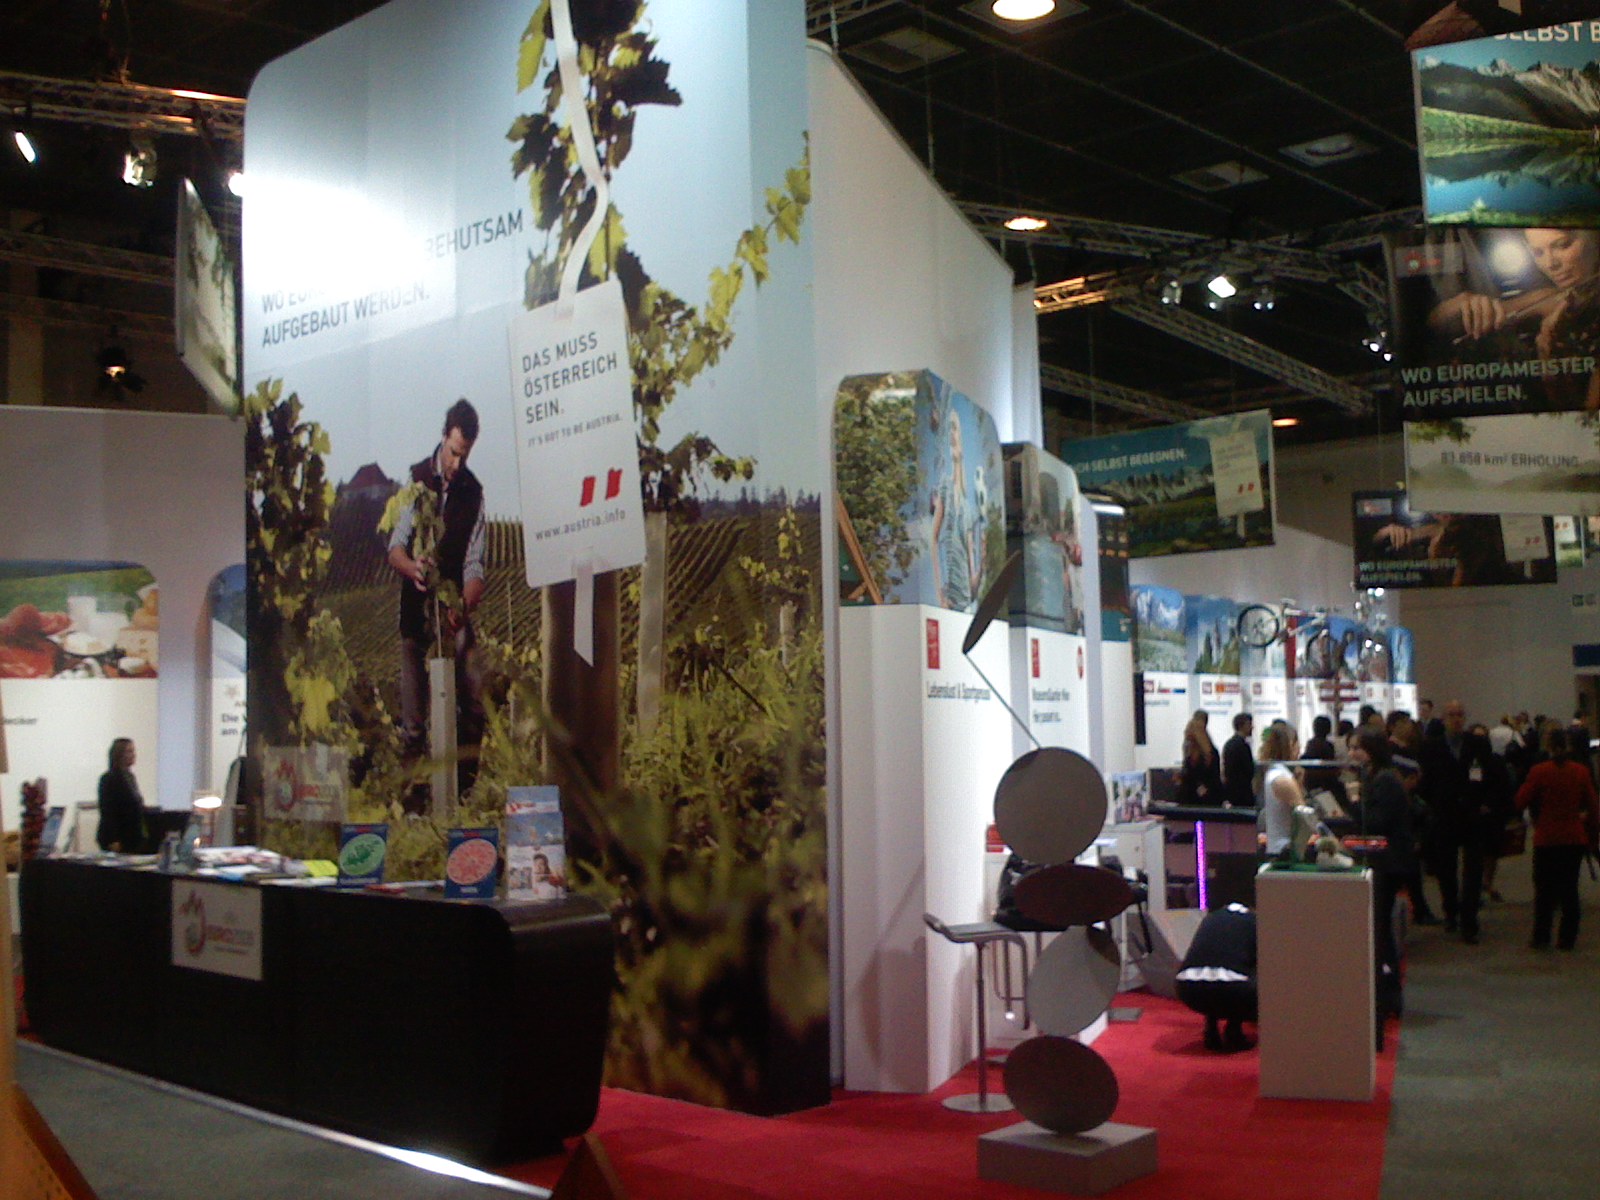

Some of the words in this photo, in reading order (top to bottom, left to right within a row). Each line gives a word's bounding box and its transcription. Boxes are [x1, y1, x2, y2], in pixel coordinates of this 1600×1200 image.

[262, 300, 349, 348] AUFGEBAUT
[522, 348, 551, 373] DAS
[556, 331, 598, 360] MUSS
[524, 351, 617, 398] ÖSTERREICH
[1401, 367, 1431, 385] WO
[1437, 356, 1596, 382] EUROPAMEISTER
[526, 397, 565, 424] SEIN.
[1402, 384, 1528, 408] AUFSPIELEN.
[535, 507, 626, 540] www.austria.info
